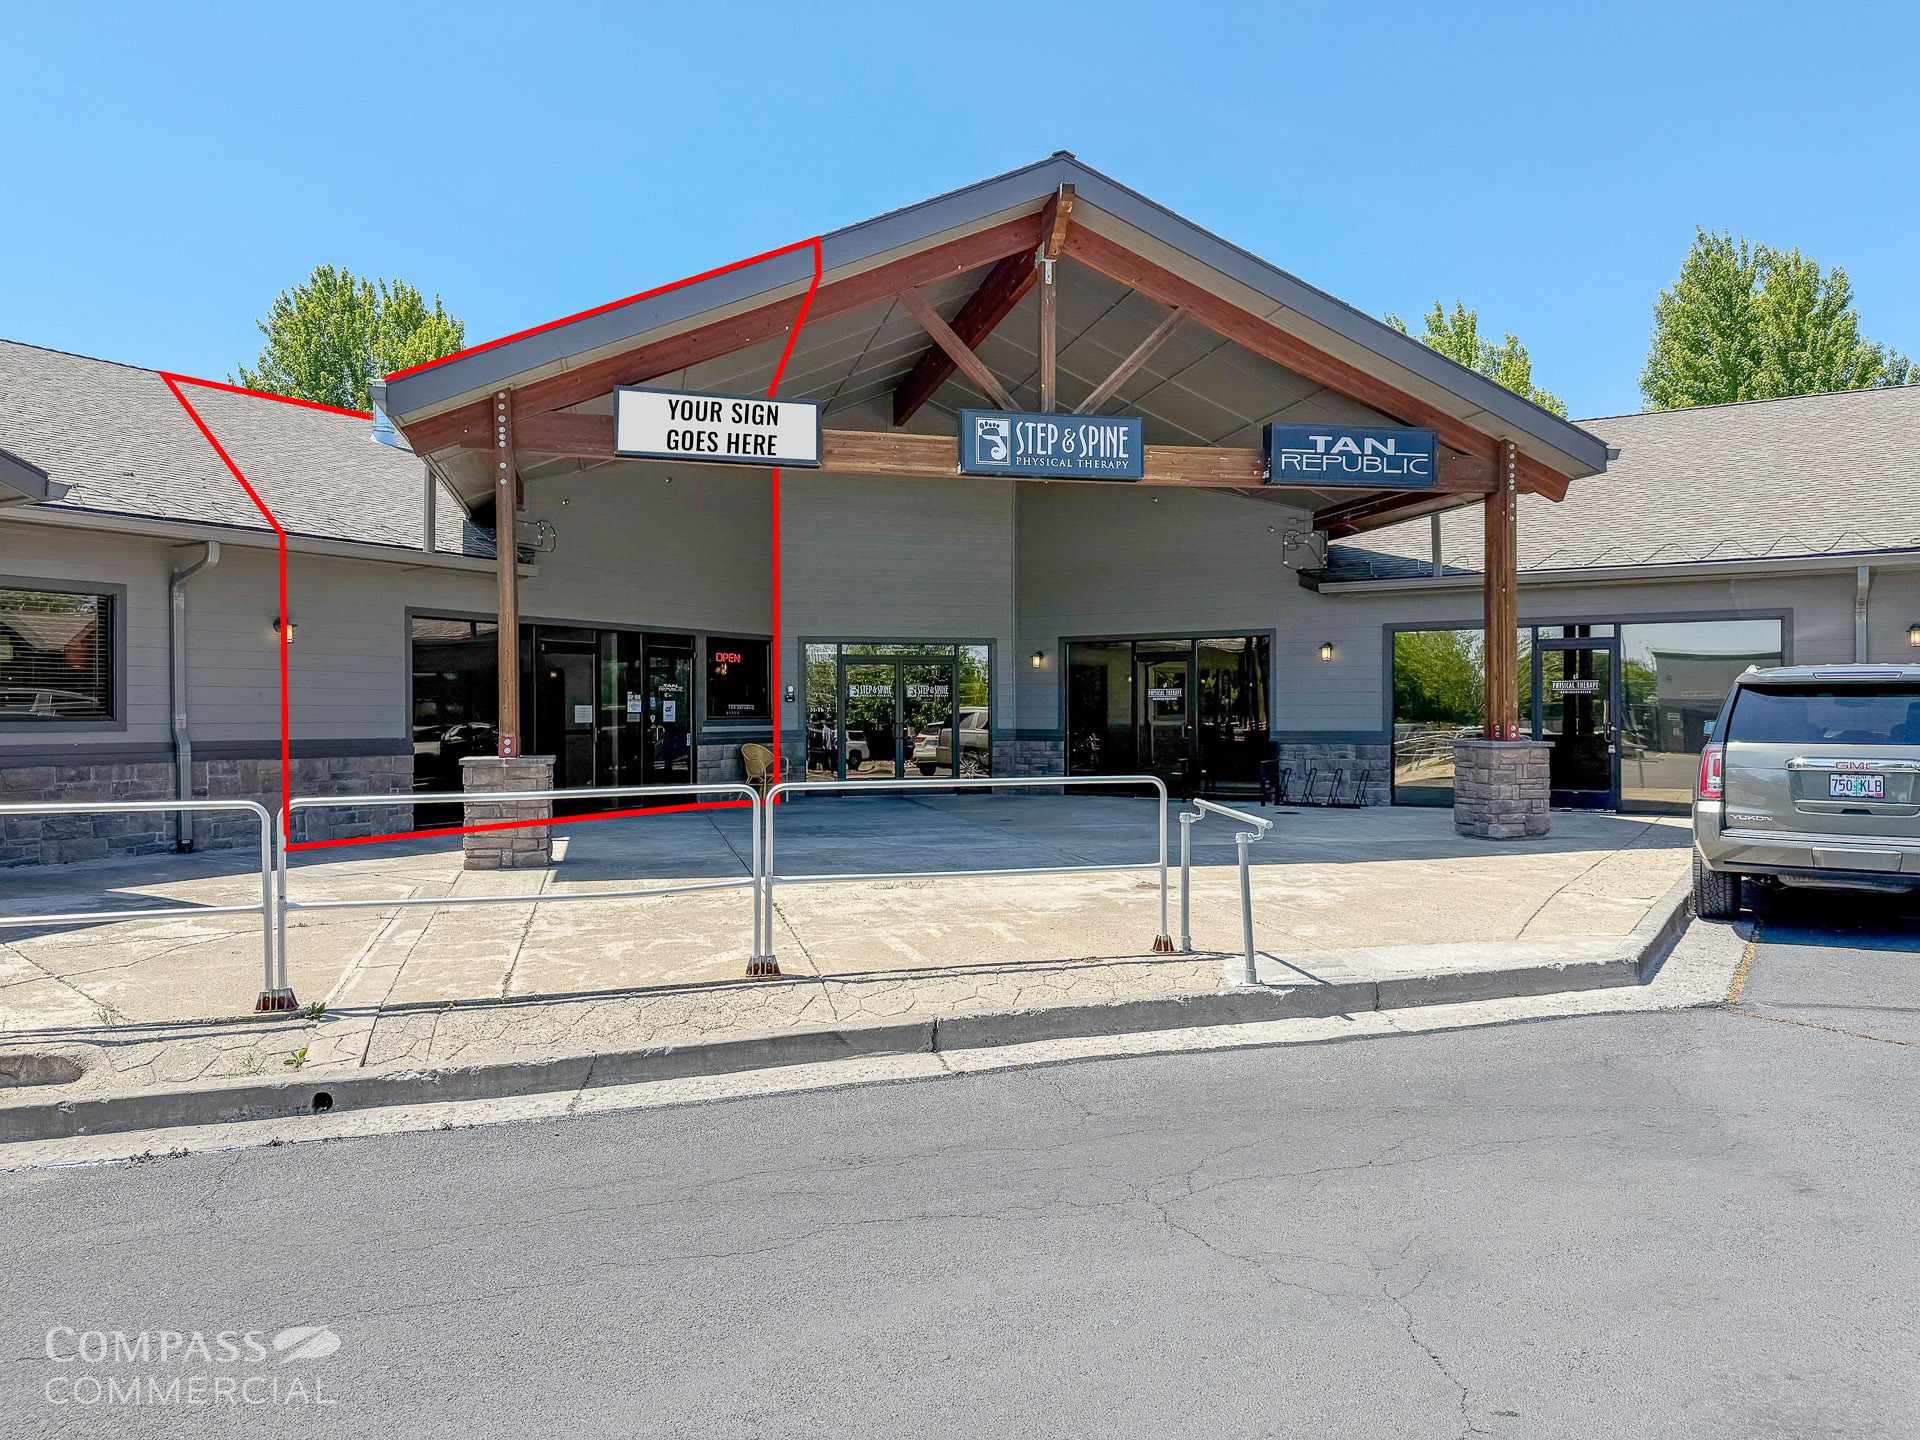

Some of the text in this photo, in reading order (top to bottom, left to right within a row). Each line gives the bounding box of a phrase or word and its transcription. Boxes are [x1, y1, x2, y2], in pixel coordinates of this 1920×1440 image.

[667, 398, 779, 426] YOUR SIGN
[666, 429, 778, 456] GOES HERE
[1015, 421, 1130, 459] STEP & SPINE
[1308, 435, 1396, 456] TAN
[1016, 457, 1129, 470] PHYSICAL THERAPY
[1281, 453, 1429, 475] REPUBLIC
[715, 652, 741, 663] OPEN
[860, 684, 872, 695] STEP
[917, 685, 930, 695] STEP
[1835, 761, 1880, 771] GMC
[1831, 778, 1882, 793] 750 KLB
